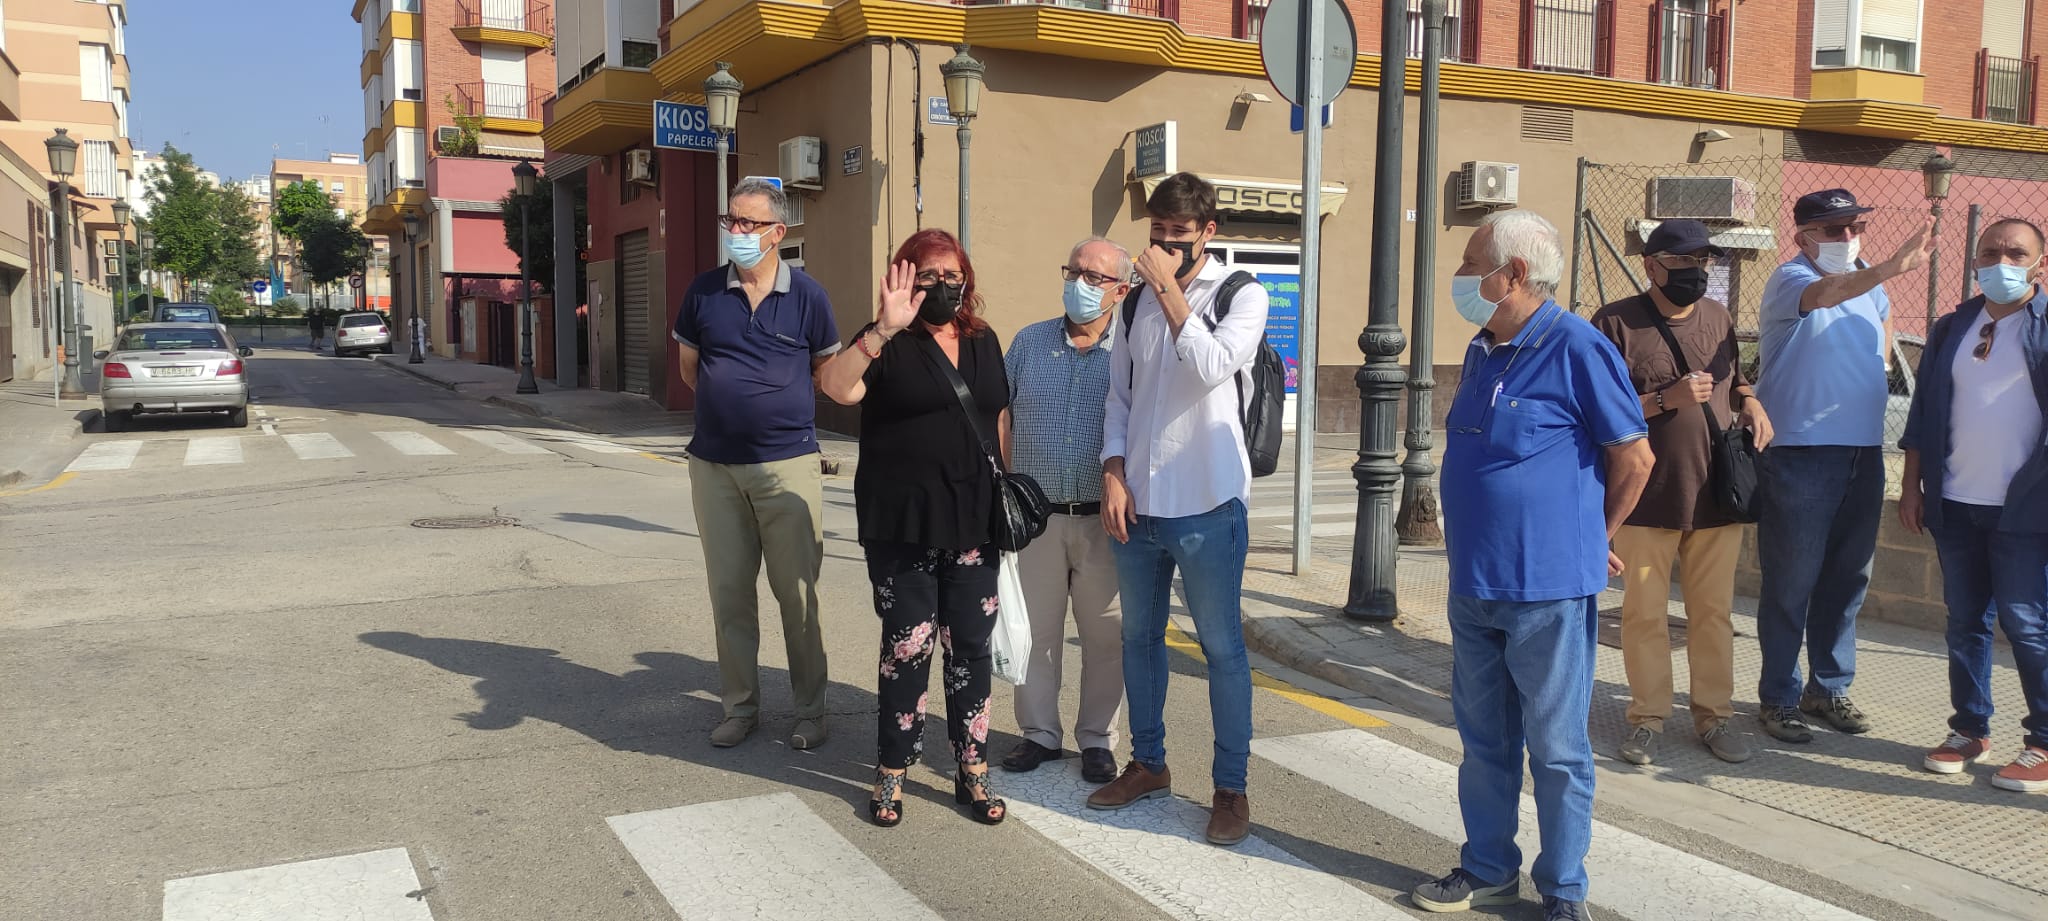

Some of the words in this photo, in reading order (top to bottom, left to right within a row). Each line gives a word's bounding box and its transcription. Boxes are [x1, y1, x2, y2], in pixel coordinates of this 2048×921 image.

[658, 106, 709, 132] KIOS
[667, 132, 717, 148] PAPELERI
[1136, 127, 1166, 149] KIOSCO
[1216, 186, 1302, 209] OSCO
